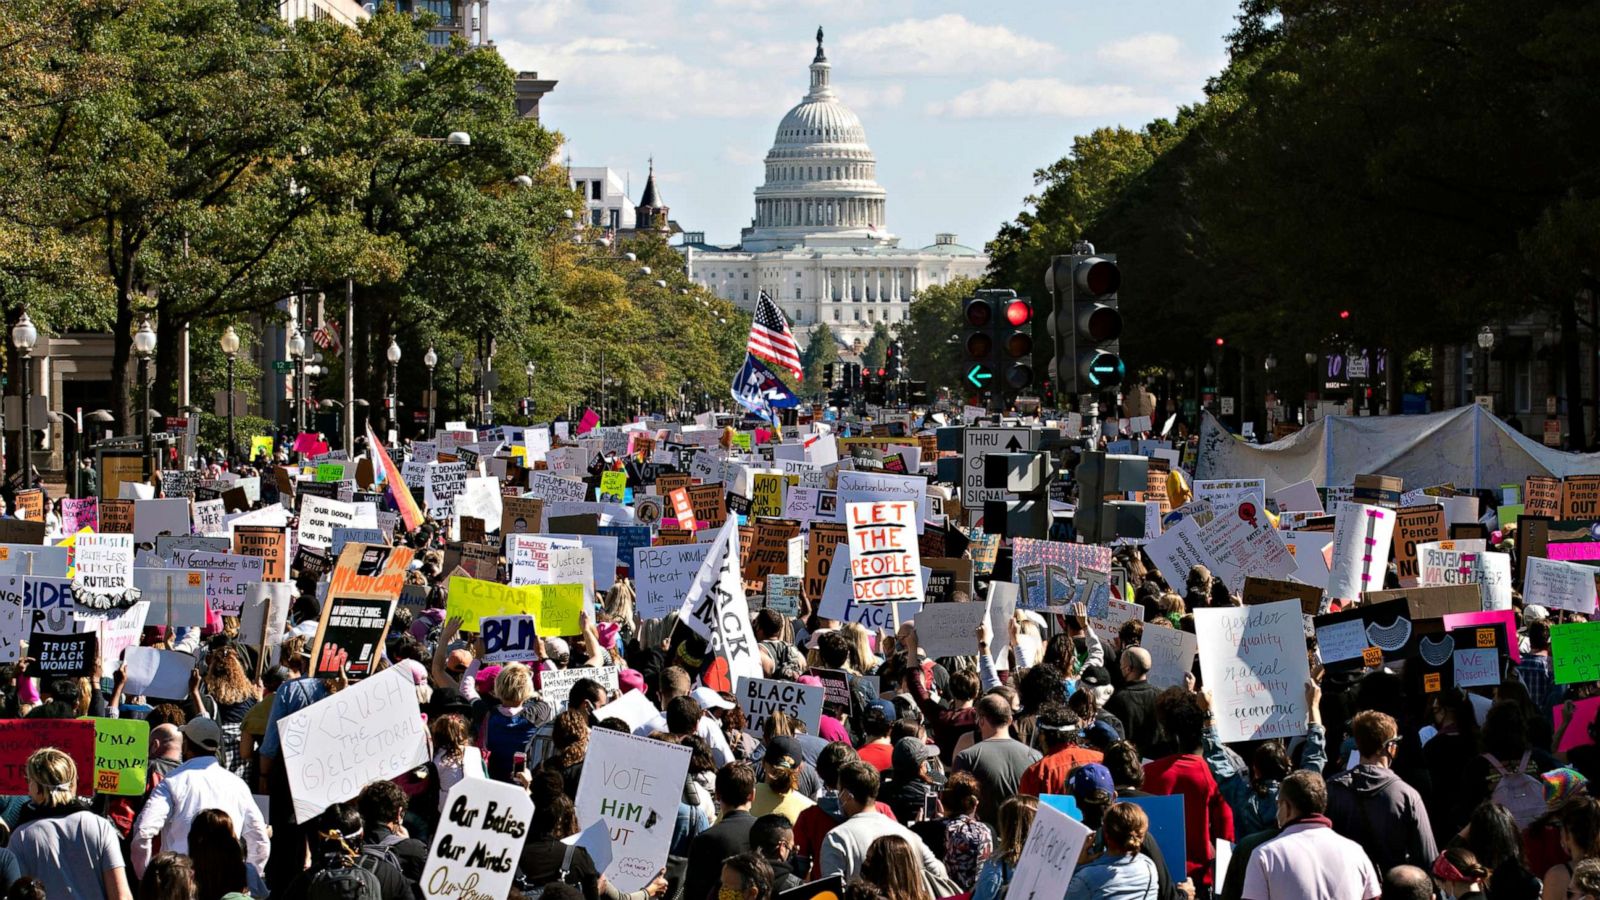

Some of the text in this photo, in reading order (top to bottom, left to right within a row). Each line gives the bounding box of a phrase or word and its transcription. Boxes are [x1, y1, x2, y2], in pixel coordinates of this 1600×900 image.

[968, 433, 998, 446] THRU
[408, 465, 426, 474] WHEN
[431, 464, 466, 475] I DEMAND
[696, 462, 711, 475] rbg
[786, 462, 813, 473] DITCH
[432, 481, 466, 492] BETWEEN
[536, 474, 566, 487] TRUMP
[754, 479, 777, 494] WHO
[1528, 481, 1557, 491] Trump/
[534, 483, 585, 500] 99 PROBLEMS
[690, 489, 720, 499] Trump/
[904, 481, 919, 498] Say
[1529, 490, 1555, 498] Pence
[1570, 491, 1598, 499] Pence
[18, 495, 40, 505] Trump/
[693, 499, 720, 508] Pence
[25, 509, 42, 519] UERA
[102, 504, 130, 513] Trump/
[314, 507, 353, 520] OUR BODIES
[436, 507, 454, 517] STA
[696, 507, 720, 521] OUT
[752, 507, 781, 518] WORLD
[853, 504, 907, 524] LET
[1571, 501, 1597, 514] OUT
[103, 512, 128, 520] Pence
[201, 513, 221, 525] HER
[1397, 512, 1439, 527] Trump/
[310, 519, 325, 527] OUR
[301, 532, 316, 540] OUR
[757, 526, 795, 537] Trump/
[816, 531, 849, 544] Trum
[1401, 528, 1438, 538] Pence
[239, 534, 281, 547] Trump/
[856, 528, 902, 550] THE
[242, 547, 278, 557] Pence
[639, 548, 707, 568] RBG would
[173, 551, 237, 569] My Grandmother
[551, 552, 585, 568] Justice
[853, 556, 913, 576] PEOPLE
[83, 575, 126, 588] RUTHLESS
[220, 572, 233, 583] for
[648, 568, 682, 583] treat
[224, 586, 235, 595] the
[855, 580, 914, 600] DECIDE
[1018, 564, 1111, 607] FDT
[23, 581, 74, 609] BIDE
[647, 590, 664, 604] like
[844, 600, 894, 630] FACE
[483, 619, 535, 654] BLM
[1480, 632, 1492, 640] OUT
[43, 641, 86, 651] TRUST
[1232, 632, 1283, 655] Equality
[41, 651, 84, 661] BLACK
[1365, 650, 1380, 658] OUT
[1461, 652, 1482, 666] WE
[40, 661, 83, 671] WOMEN
[563, 669, 583, 677] FORGET
[748, 681, 806, 705] BLACK
[1235, 680, 1288, 698] Equality
[319, 676, 403, 738] CRUSH
[750, 700, 799, 718] LIVES
[1240, 719, 1306, 736] Equality
[337, 725, 369, 747] THE
[302, 716, 424, 791] (S)ELECTORAL
[96, 757, 144, 770] RUMP!
[100, 775, 116, 783] OUT
[602, 759, 658, 796] VOTE
[98, 782, 118, 791] NOW
[449, 795, 525, 839] Our Bodies
[610, 826, 635, 847] UT
[437, 834, 512, 873] Our Minds
[428, 865, 457, 896] Our
